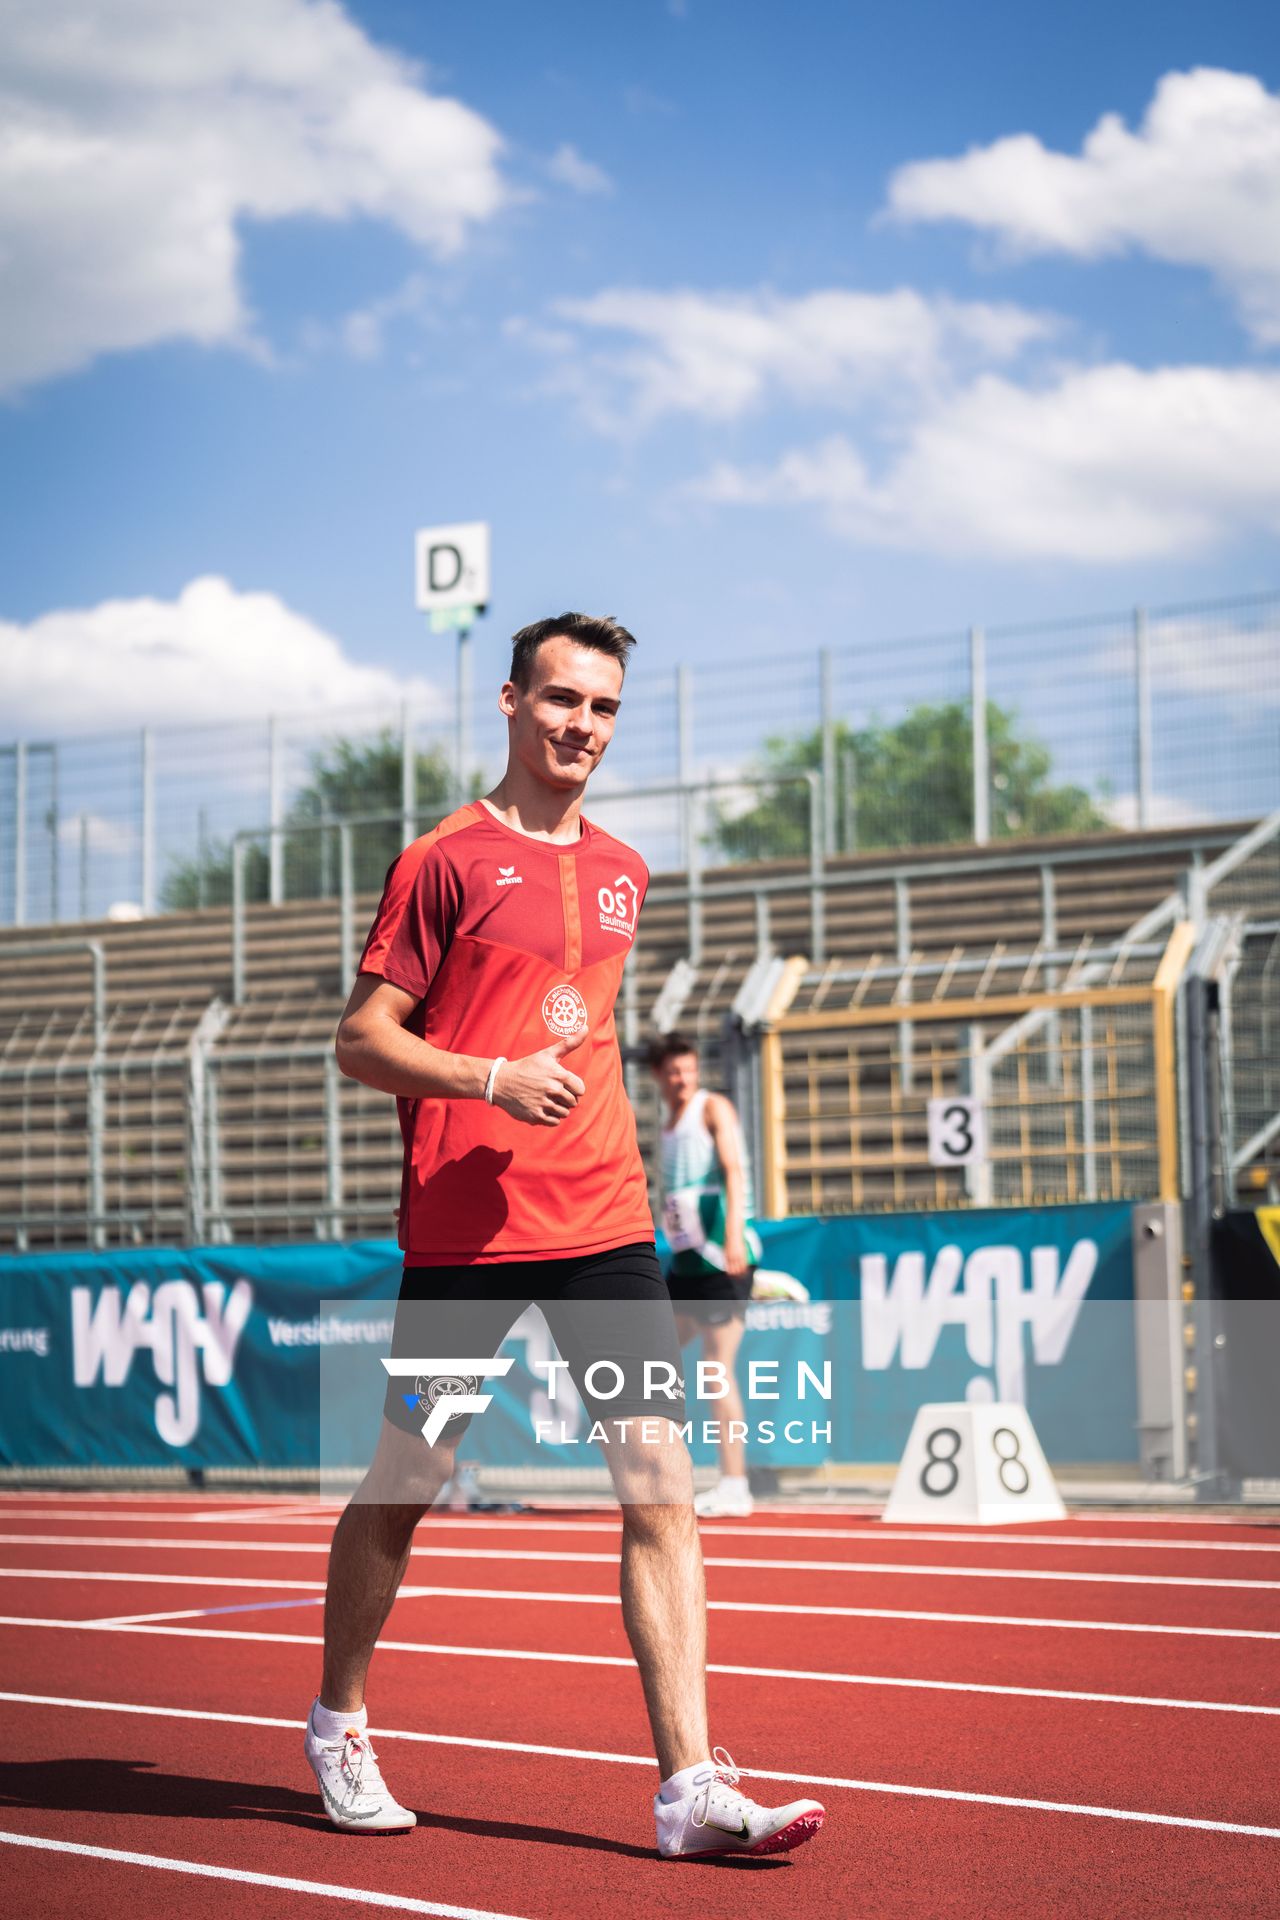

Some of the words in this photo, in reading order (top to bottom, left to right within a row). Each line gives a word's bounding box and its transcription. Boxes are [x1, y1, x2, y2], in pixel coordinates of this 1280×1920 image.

[429, 543, 463, 592] D
[598, 887, 627, 918] OS
[941, 1105, 974, 1157] 3
[920, 1427, 962, 1497] 8
[992, 1428, 1029, 1494] 8
